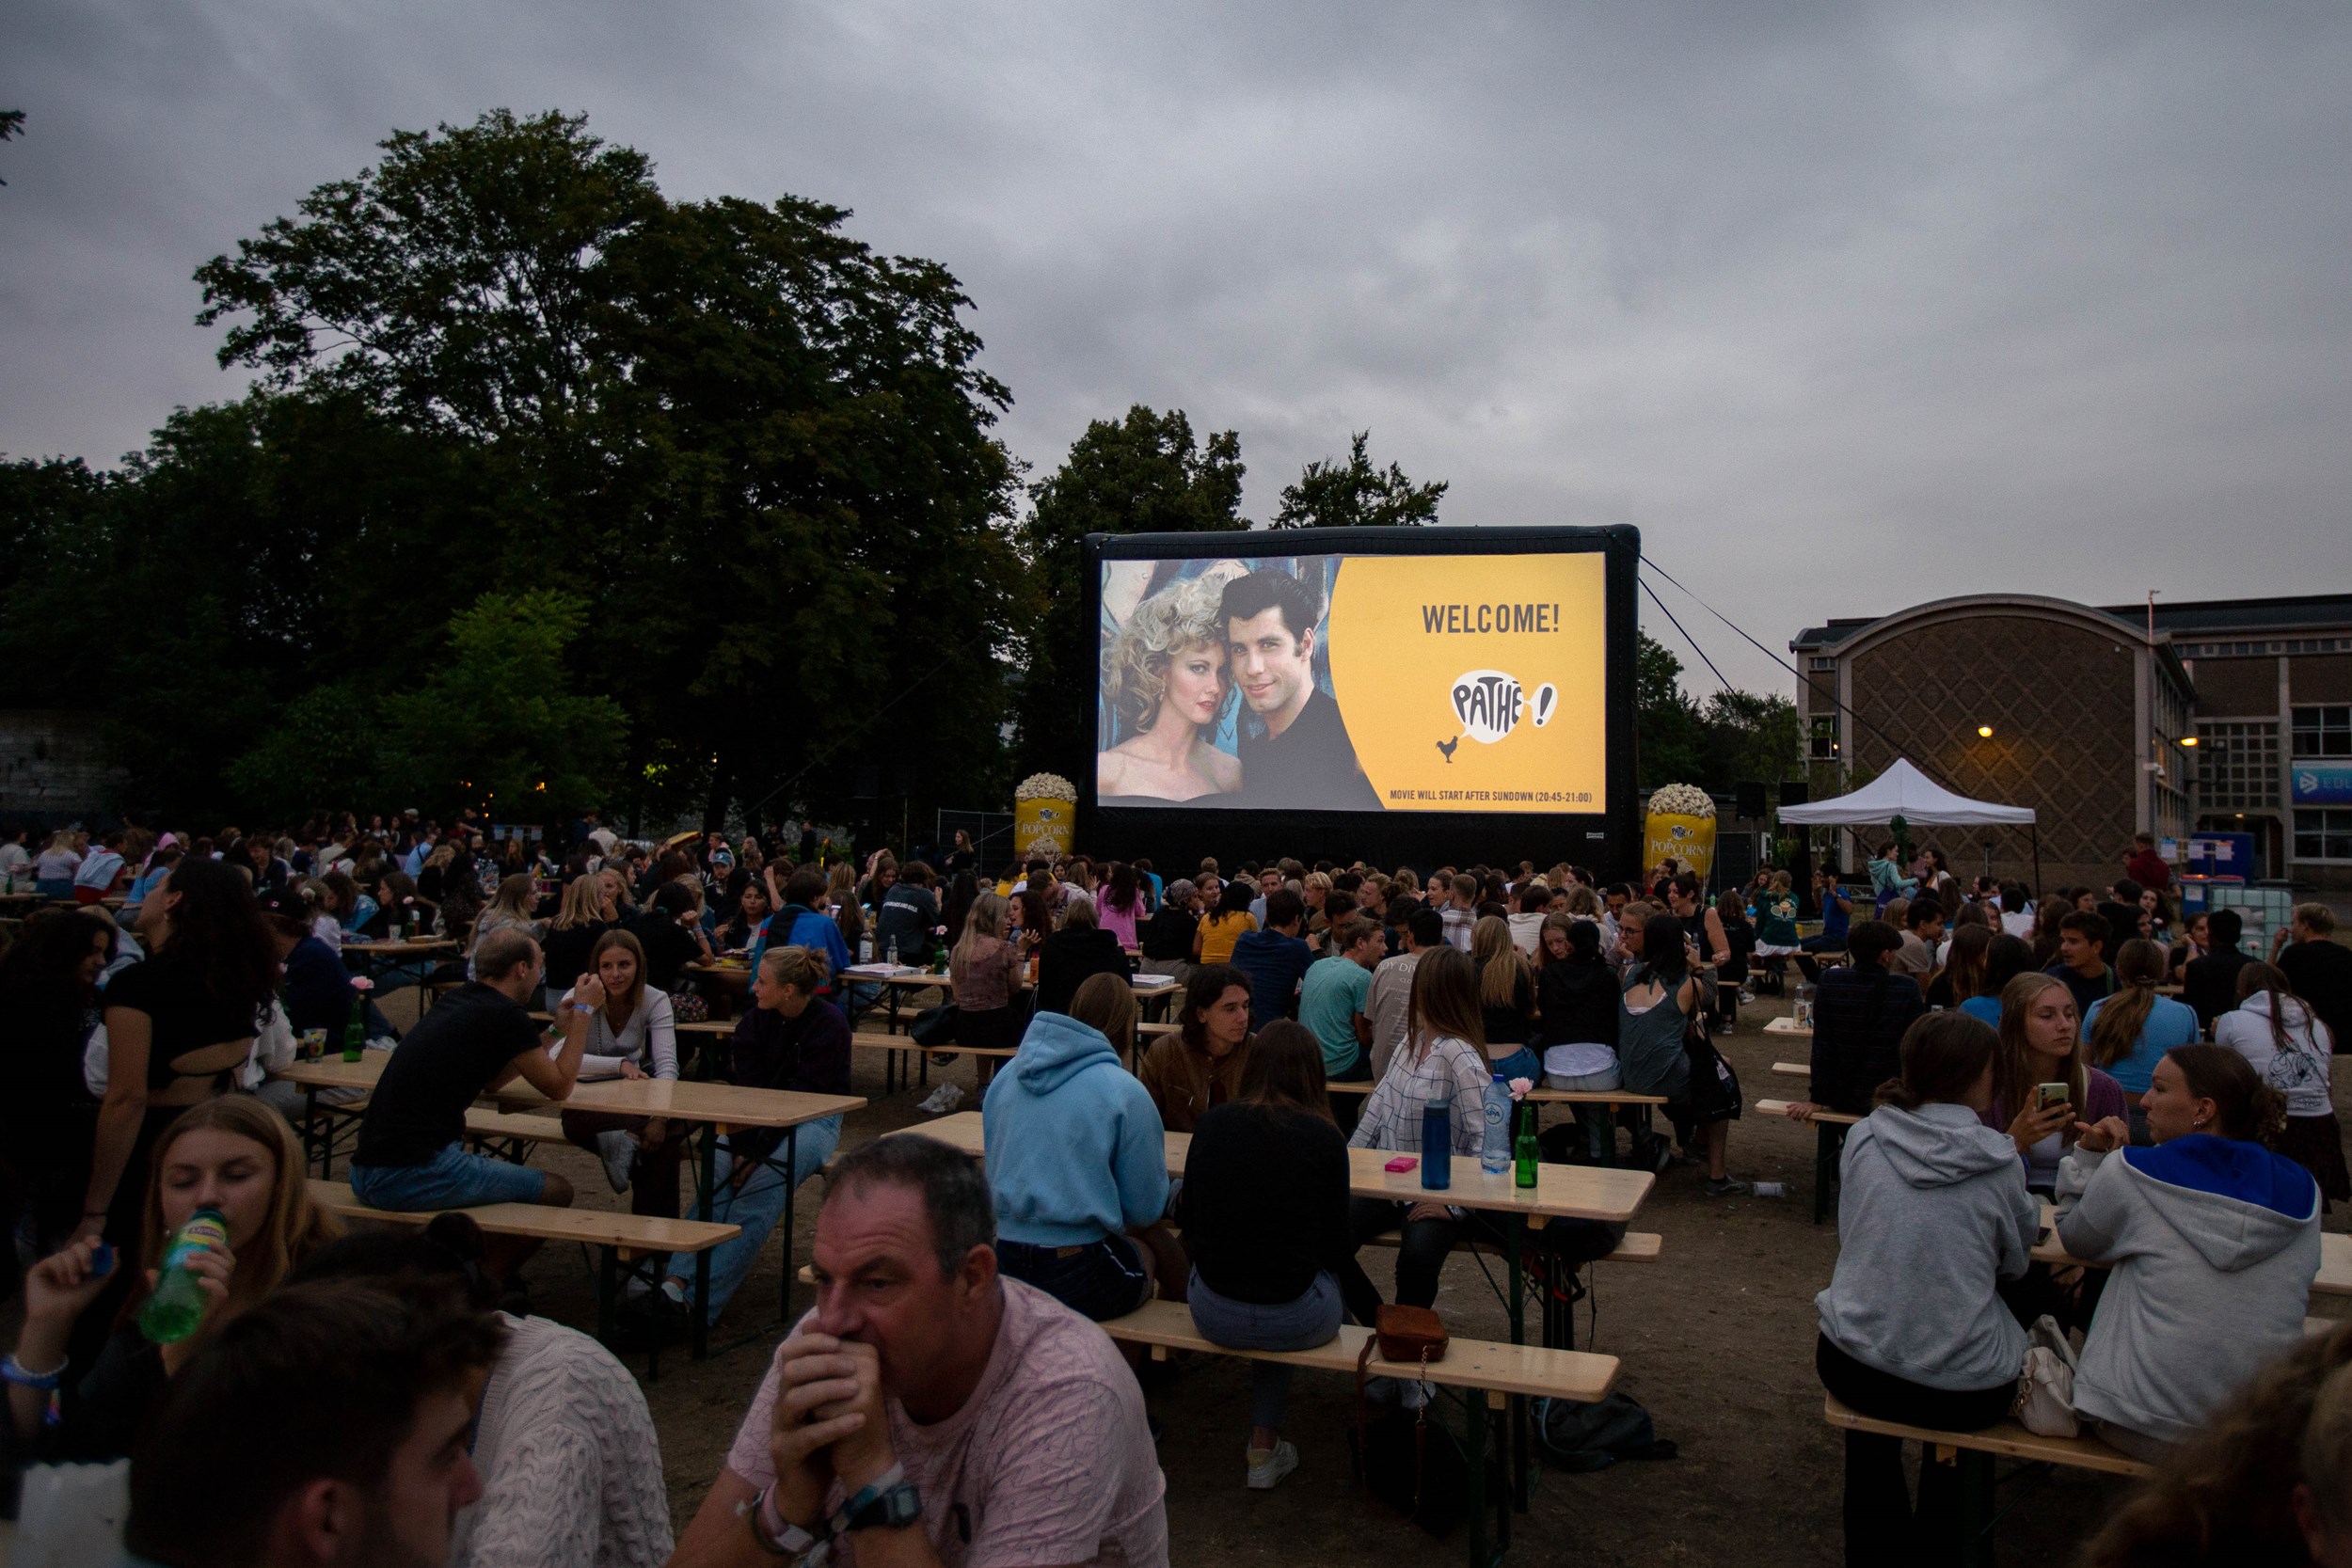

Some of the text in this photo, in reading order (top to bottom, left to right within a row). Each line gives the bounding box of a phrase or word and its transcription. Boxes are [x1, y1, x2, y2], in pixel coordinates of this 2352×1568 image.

[1422, 604, 1559, 633] WELCOME!
[1390, 789, 1592, 802] MOVIE WILL START AFTER SUNDOWN (20:45-21:00)
[1023, 824, 1069, 835] POPCORN
[1652, 840, 1704, 856] POPCORN
